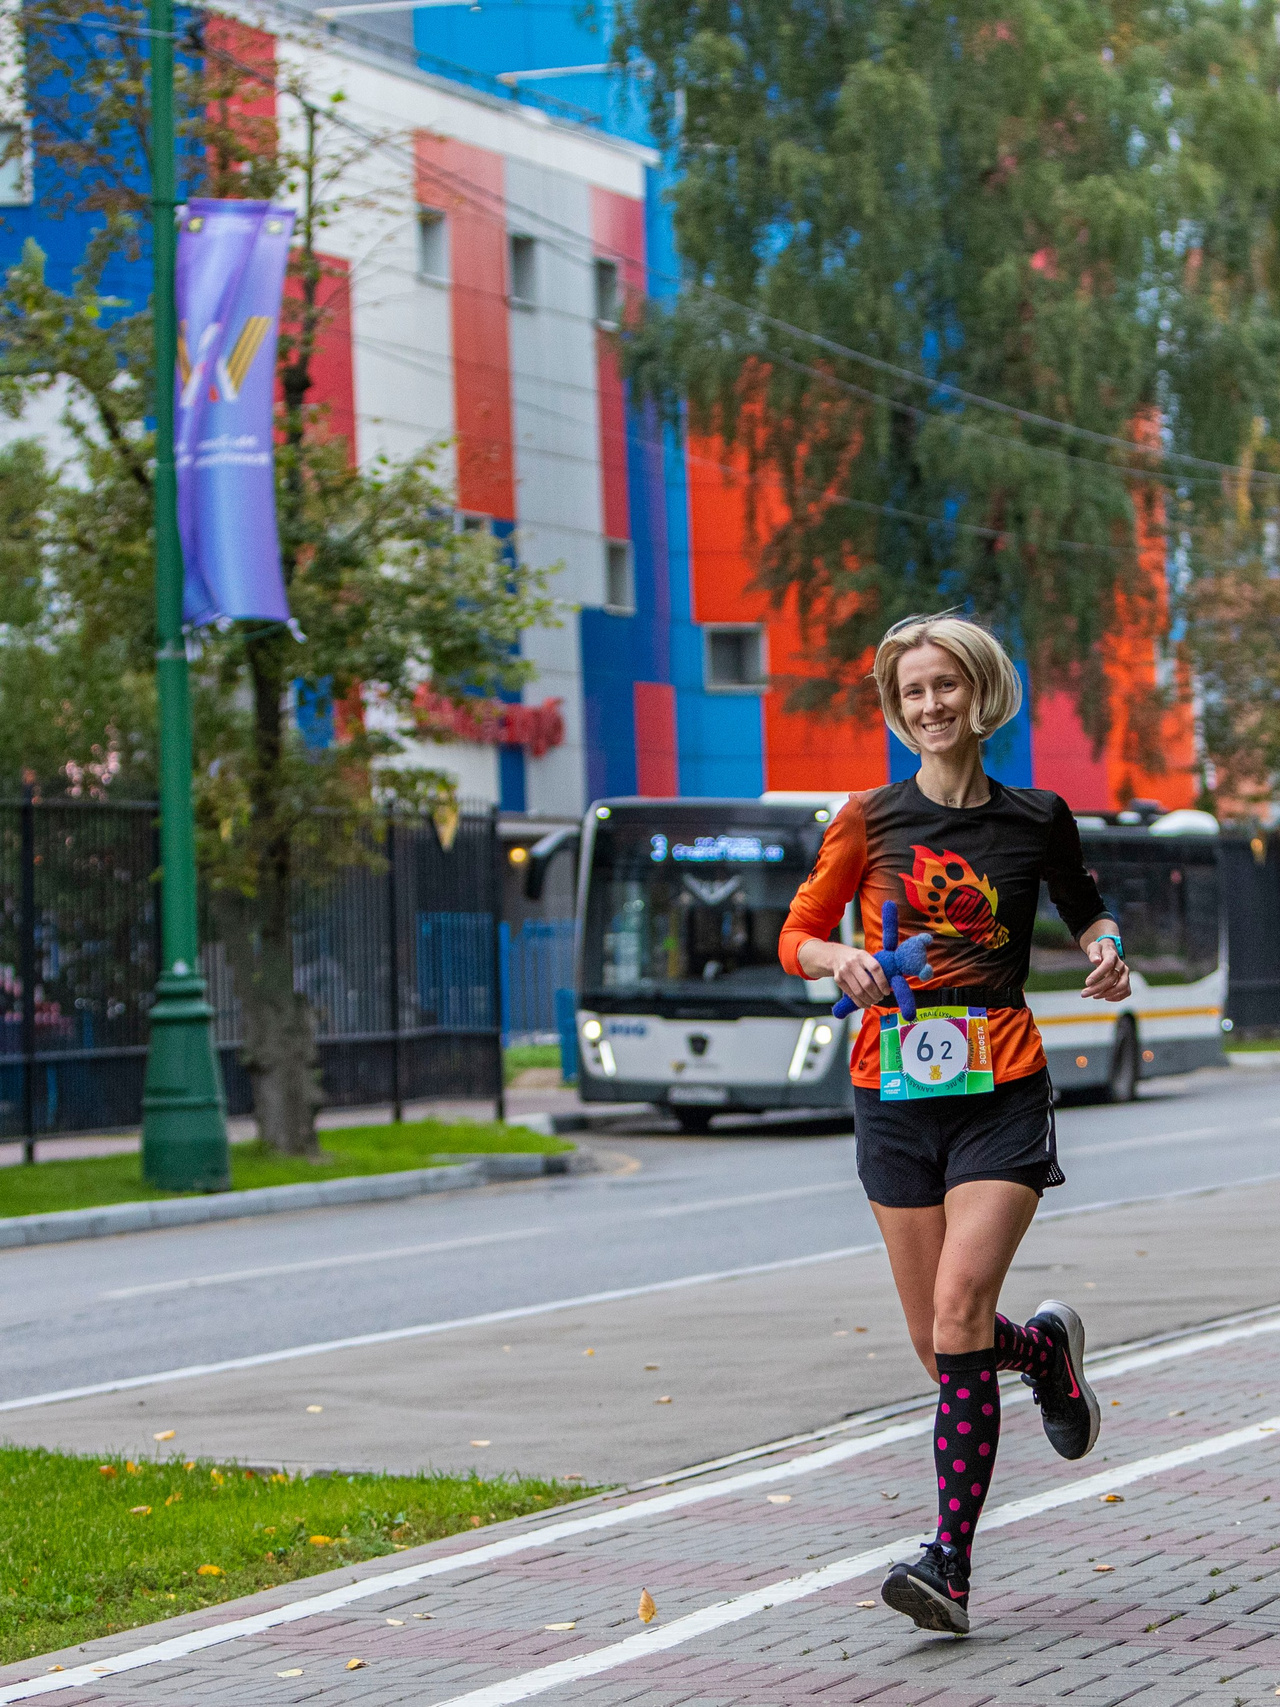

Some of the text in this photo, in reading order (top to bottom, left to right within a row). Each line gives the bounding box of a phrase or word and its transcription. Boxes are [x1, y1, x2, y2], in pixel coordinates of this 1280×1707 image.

[920, 1011, 937, 1019] TRAIL
[977, 1026, 987, 1065] ЭСТАФЕТА
[909, 1080, 934, 1093] KANNAS
[945, 1081, 958, 1090] ЛЕС
